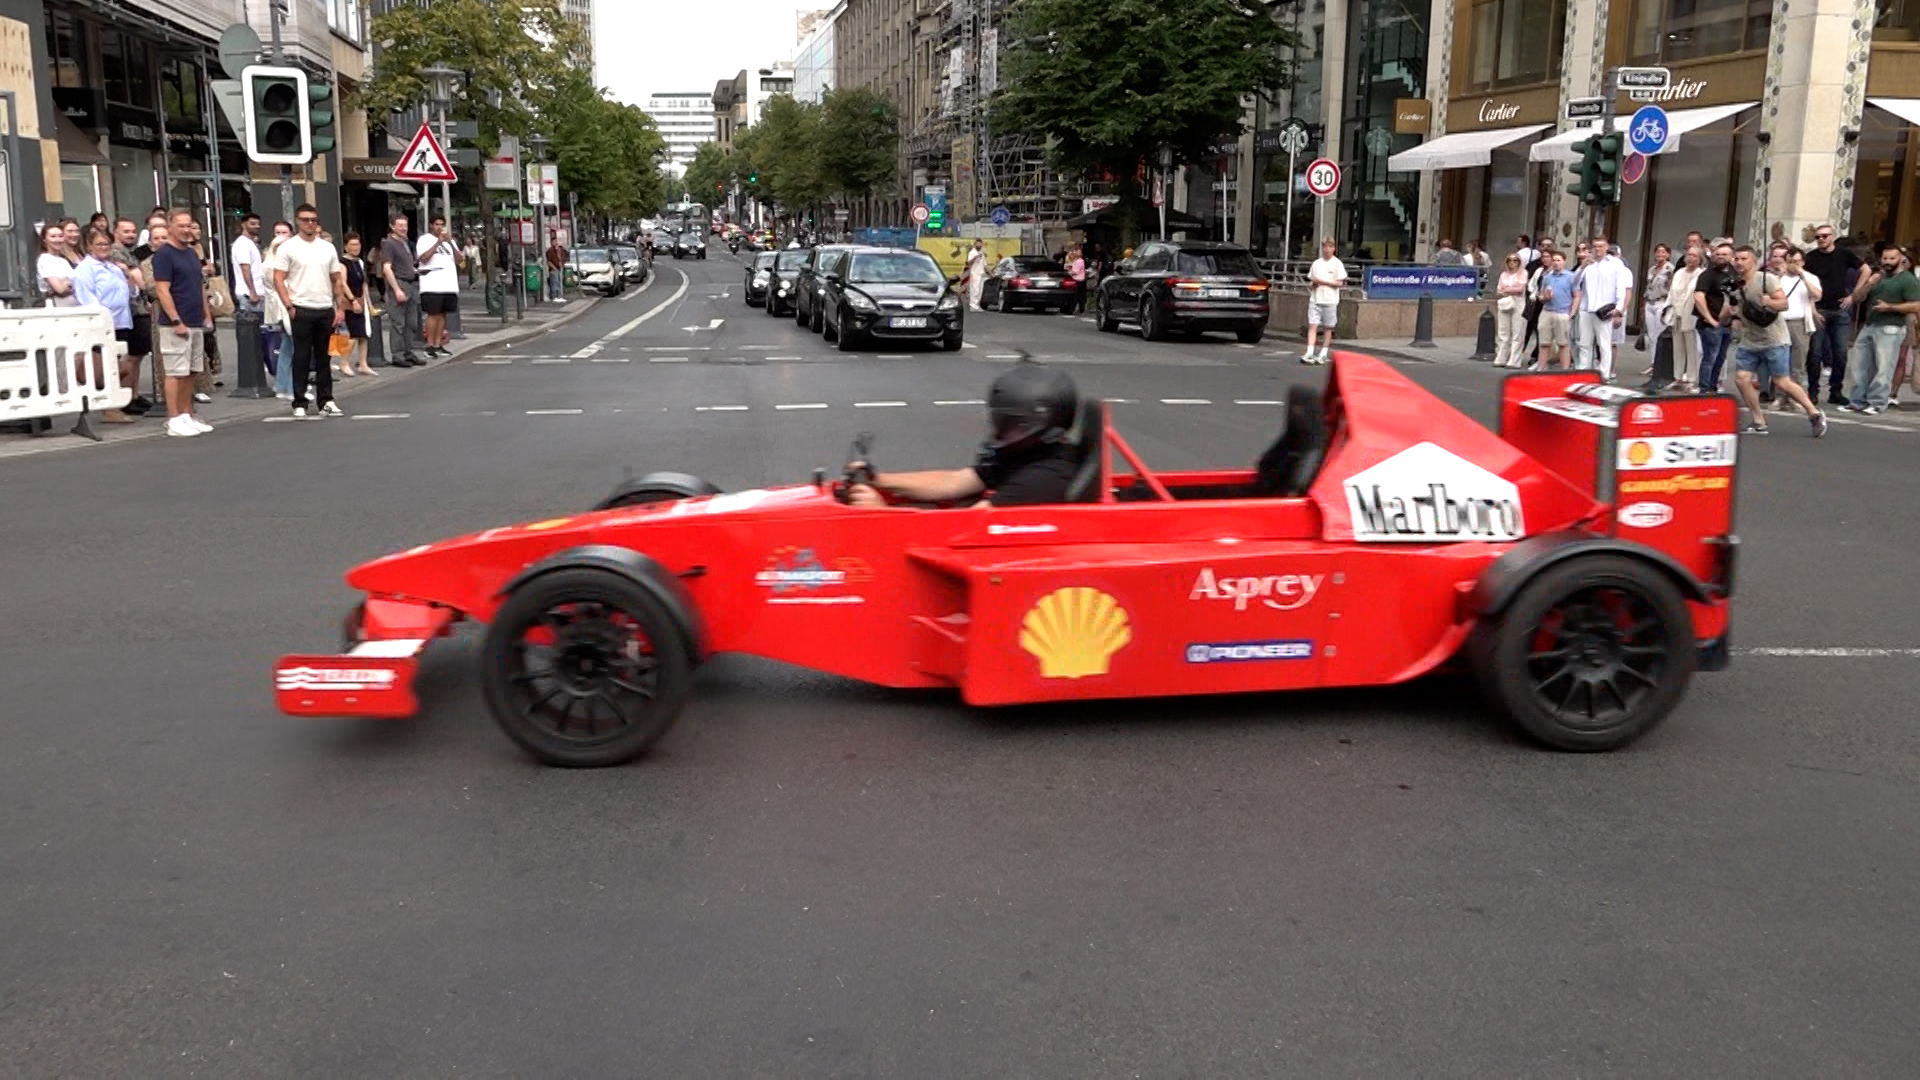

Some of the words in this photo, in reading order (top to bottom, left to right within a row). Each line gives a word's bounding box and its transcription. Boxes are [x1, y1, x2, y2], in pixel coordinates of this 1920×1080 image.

[1648, 78, 1707, 102] artier
[1479, 99, 1520, 122] Cartier
[1313, 169, 1334, 186] 30
[1350, 482, 1523, 537] Marlboro
[1188, 566, 1326, 611] Asprey
